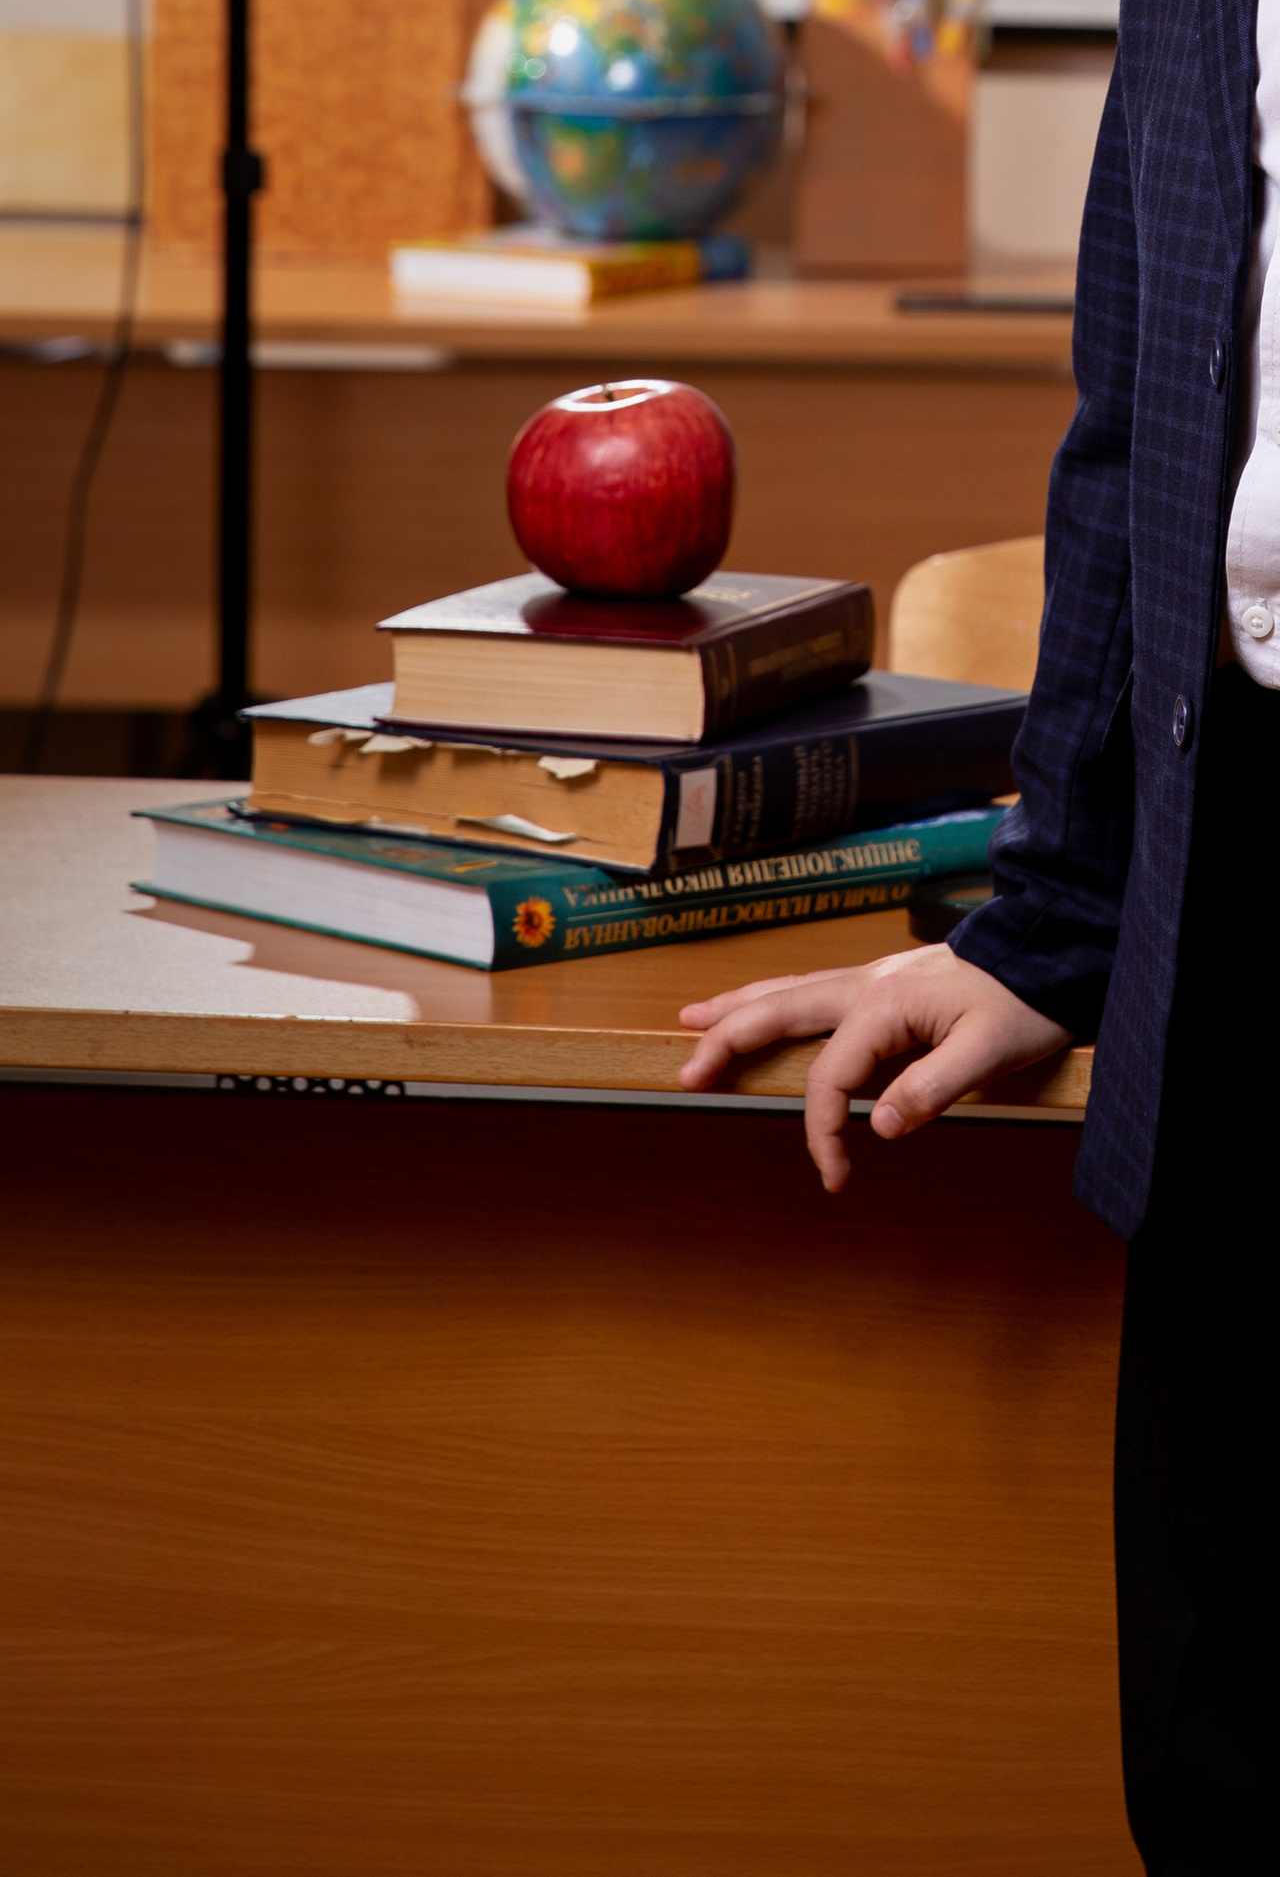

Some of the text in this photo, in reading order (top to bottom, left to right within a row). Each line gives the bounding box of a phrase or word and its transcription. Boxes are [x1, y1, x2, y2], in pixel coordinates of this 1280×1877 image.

[728, 839, 923, 887] ЭНЦИКЛОПЕДИЯ
[563, 881, 909, 951] ОЛЬШАЯ ИЛЛЮСТРИРОВАННАЯ
